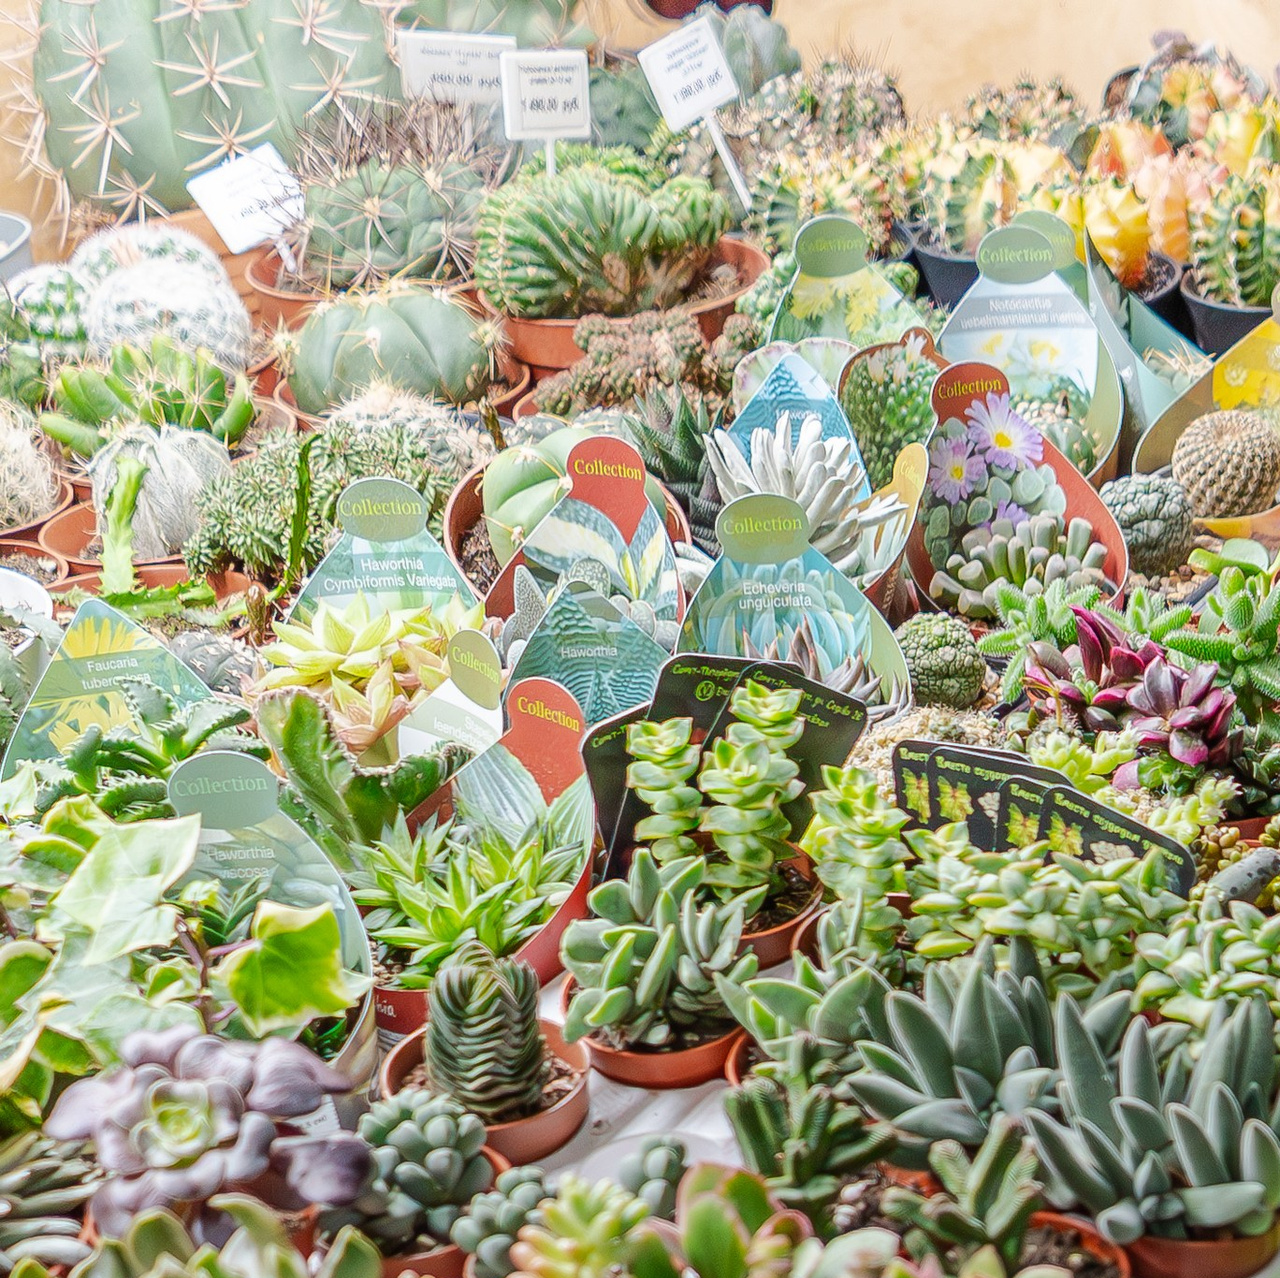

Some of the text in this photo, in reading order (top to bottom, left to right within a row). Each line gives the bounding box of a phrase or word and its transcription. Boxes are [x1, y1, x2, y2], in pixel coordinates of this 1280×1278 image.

[979, 246, 1053, 264] Collection
[937, 376, 1002, 400] Collection
[573, 458, 643, 482] Collection
[339, 499, 423, 518] Collection
[723, 516, 803, 535] Collection
[360, 557, 424, 572] Haworthia
[323, 571, 457, 592] Cymbiformis Variegata
[742, 582, 806, 595] Echeveria
[739, 595, 812, 611] unguiculata
[561, 646, 618, 659] Haworthia
[86, 656, 139, 673] Faucaria
[452, 646, 500, 685] Collection
[517, 696, 580, 733] Collection
[174, 775, 268, 797] Collection
[206, 846, 276, 861] Haworthia
